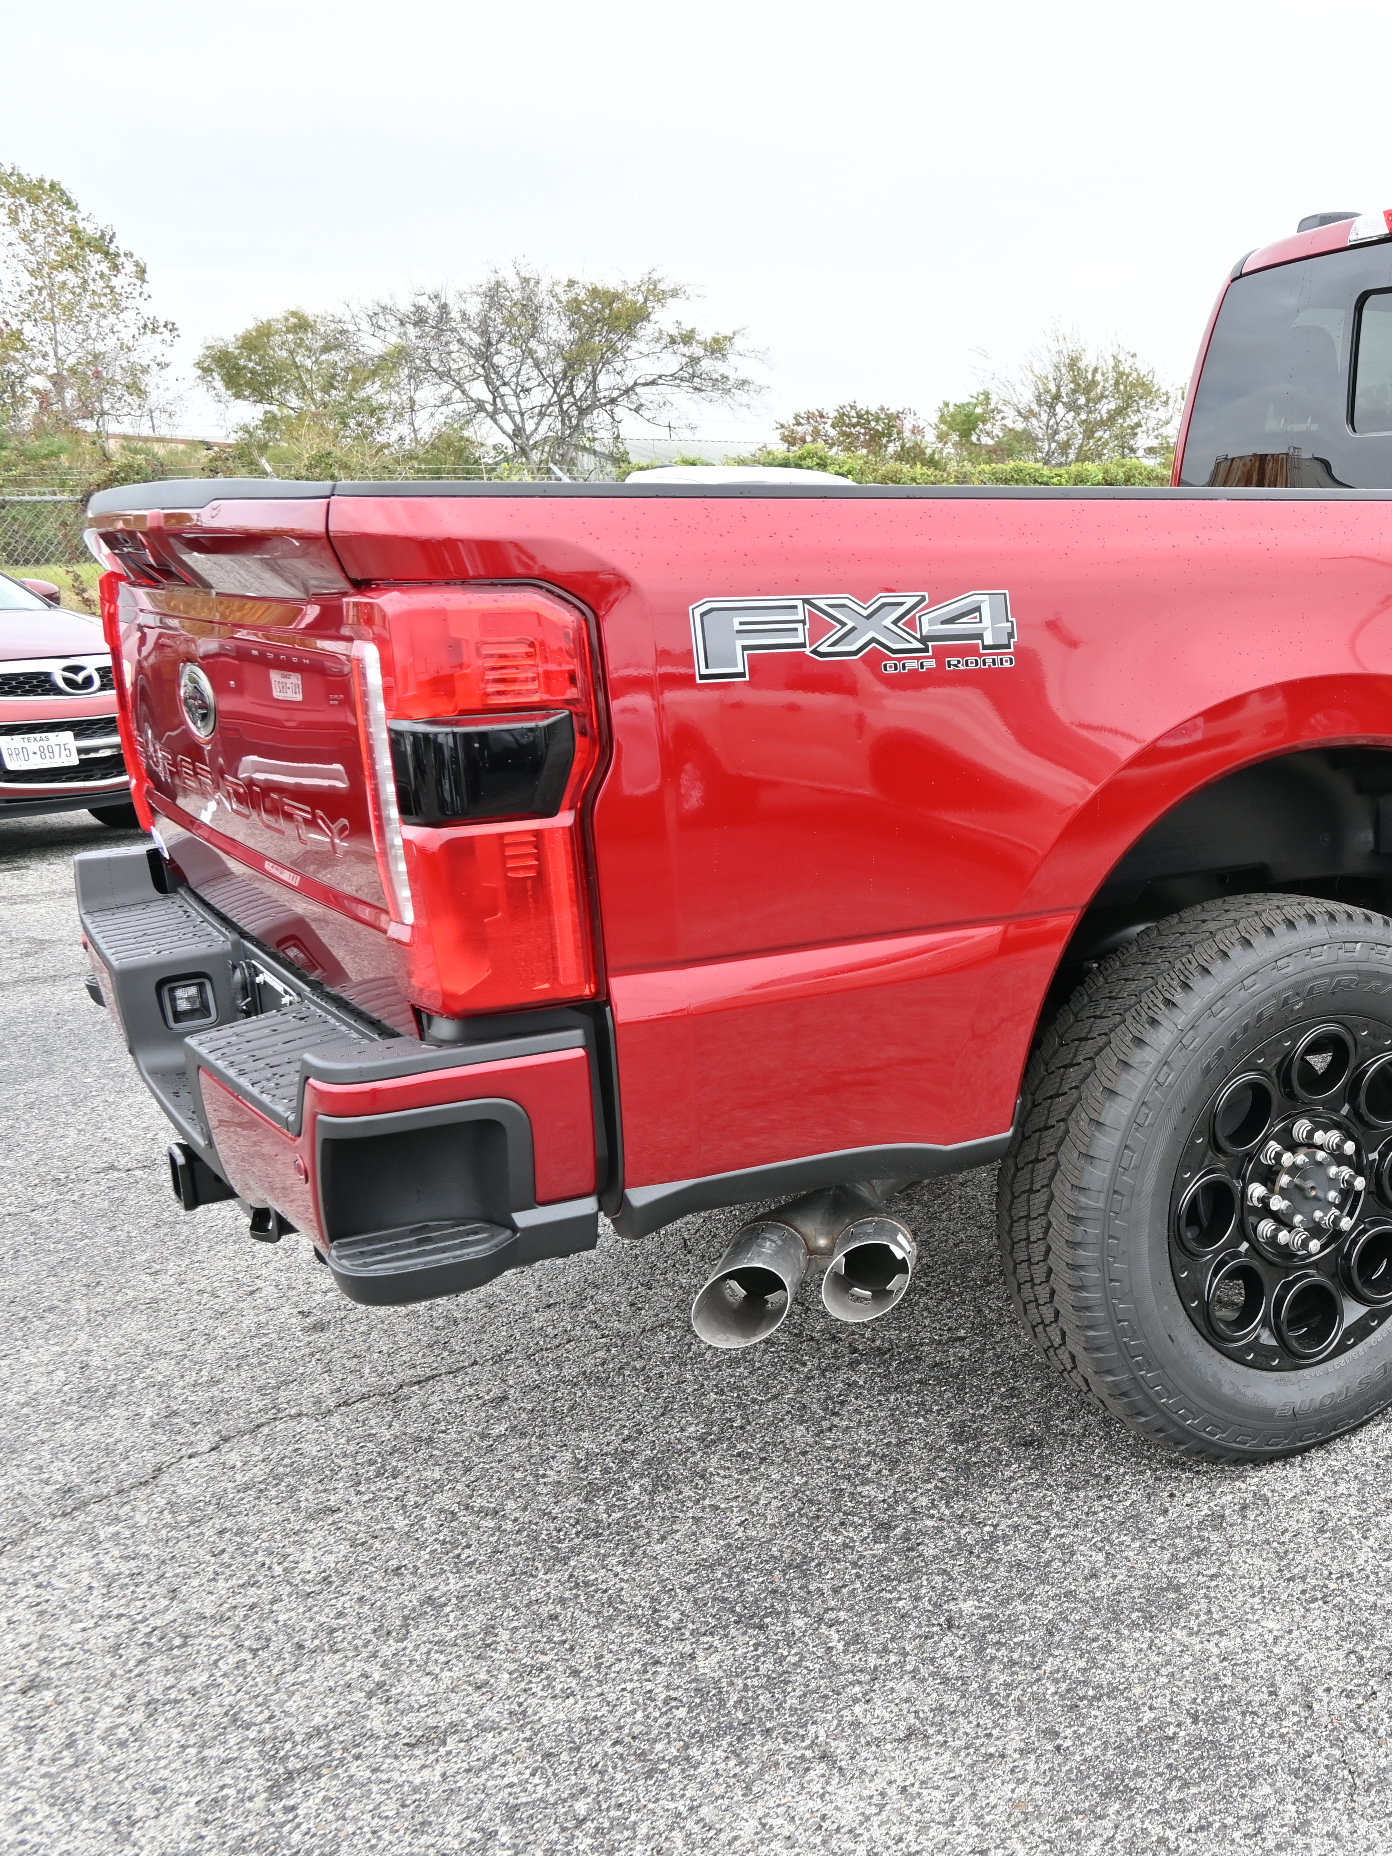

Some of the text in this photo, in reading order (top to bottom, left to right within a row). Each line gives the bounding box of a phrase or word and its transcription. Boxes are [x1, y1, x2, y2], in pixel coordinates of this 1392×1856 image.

[689, 590, 1017, 683] FX4
[882, 655, 1016, 674] OFF ROAD
[21, 735, 50, 743] TEXAS
[223, 773, 350, 858] DUTY
[1203, 975, 1360, 1080] DUELER
